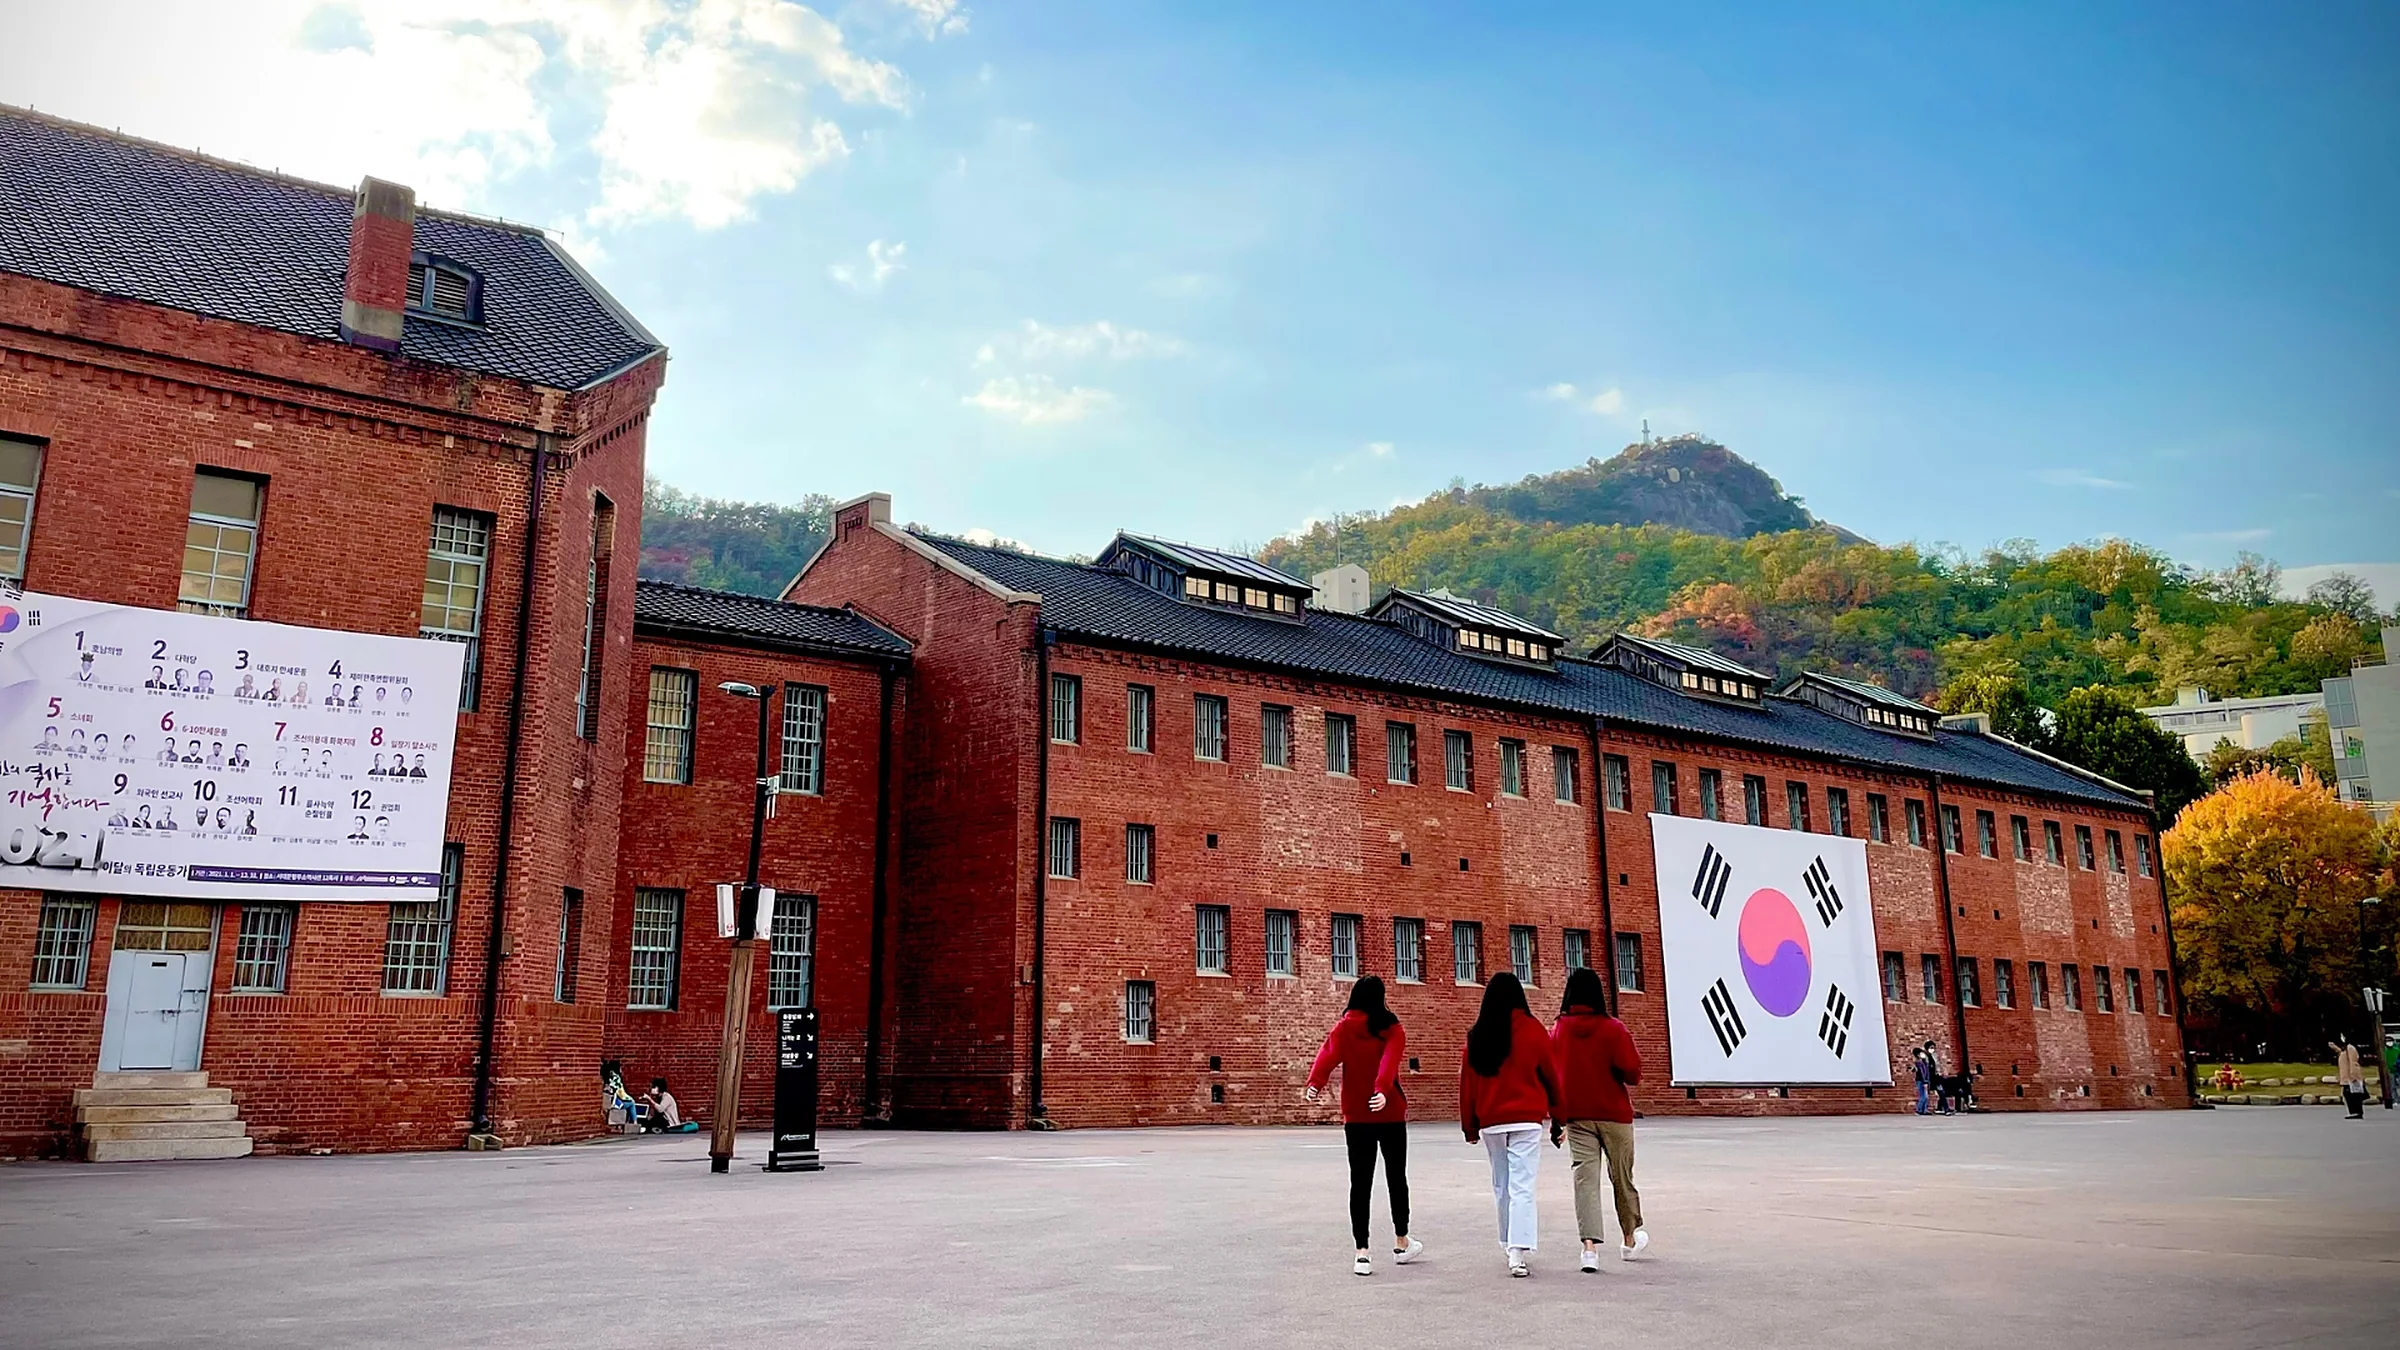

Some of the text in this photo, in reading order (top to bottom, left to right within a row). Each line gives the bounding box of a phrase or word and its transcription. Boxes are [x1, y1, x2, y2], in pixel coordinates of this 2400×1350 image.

[91, 644, 123, 656] 호남의병
[279, 666, 307, 676] 만세운동
[136, 788, 184, 801] 외국인 선교사
[226, 795, 263, 806] 조선어학회
[8, 787, 110, 822] 기억합니다
[102, 861, 188, 878] 이달의 독립운동가
